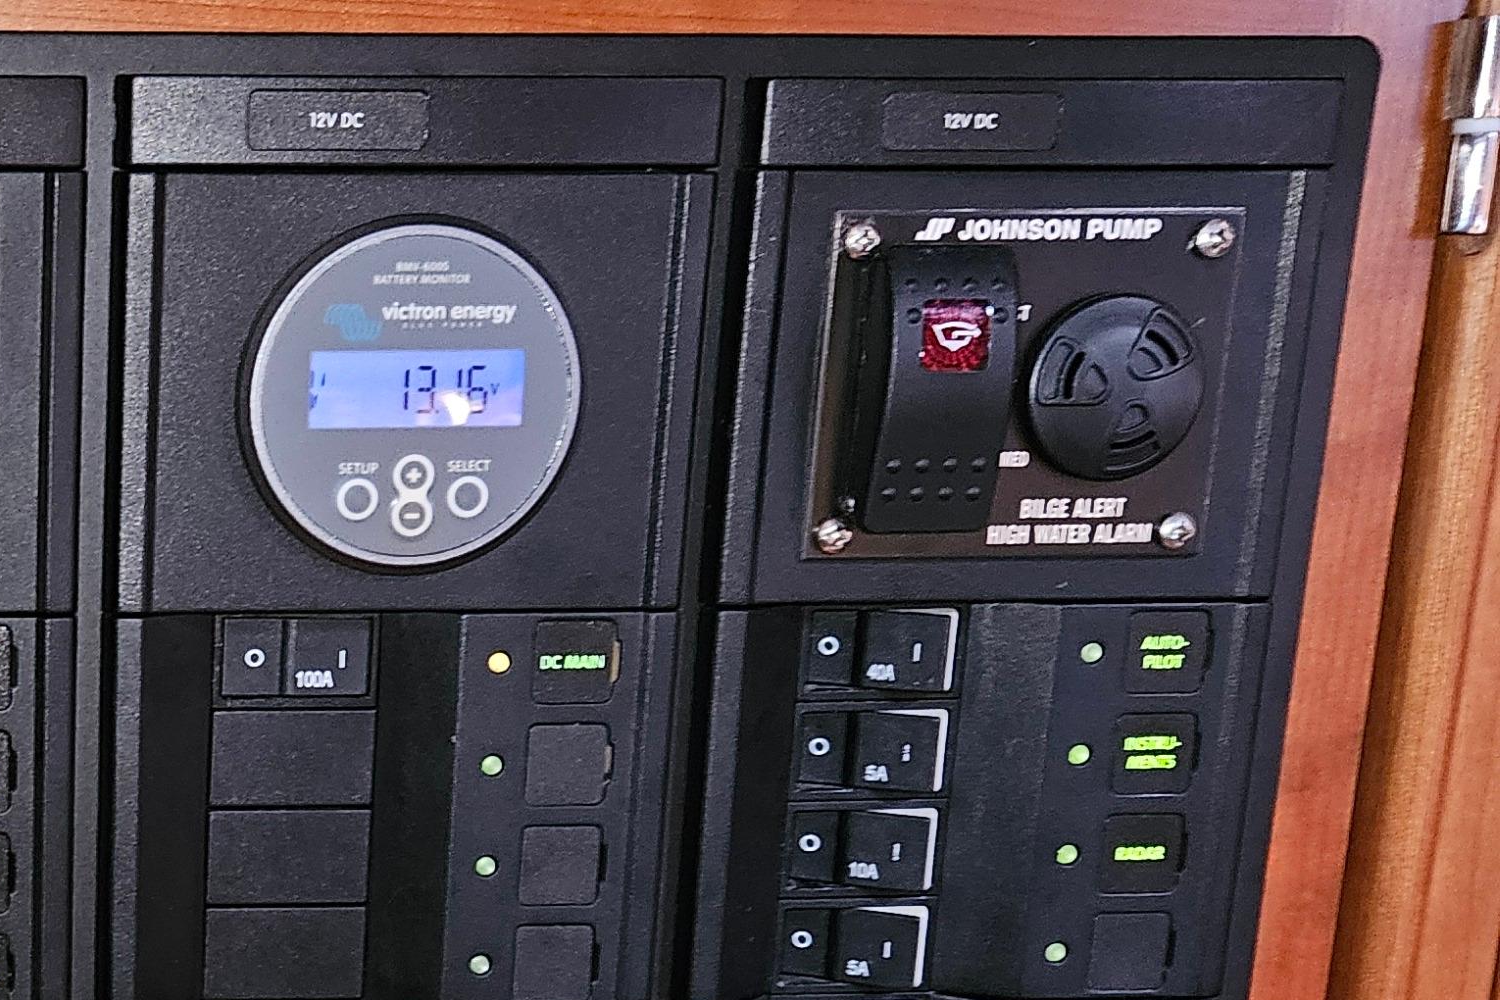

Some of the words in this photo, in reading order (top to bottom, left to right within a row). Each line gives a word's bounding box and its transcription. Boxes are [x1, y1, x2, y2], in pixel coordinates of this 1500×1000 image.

[309, 112, 337, 128] 12V
[341, 112, 364, 128] DC
[944, 114, 971, 129] 12V
[974, 114, 998, 129] DC
[958, 218, 1081, 241] JOHNSON
[1087, 218, 1162, 240] PUMP
[373, 274, 420, 285] BATTERY
[421, 274, 471, 285] MONITOR
[382, 302, 447, 321] victron
[451, 304, 517, 324] energy
[339, 462, 379, 475] SETUP
[447, 459, 492, 472] SELECT
[1020, 498, 1069, 519] BILGE
[1074, 498, 1128, 519] ALERT
[987, 524, 1030, 545] HIGH
[1034, 524, 1090, 545] WATER
[1094, 524, 1154, 545] ALARM
[539, 655, 563, 670] DC
[1143, 655, 1185, 669] PILOT
[296, 671, 333, 687] 100A
[864, 765, 888, 781] 5A
[849, 862, 878, 879] 10A
[846, 960, 869, 976] 5A
